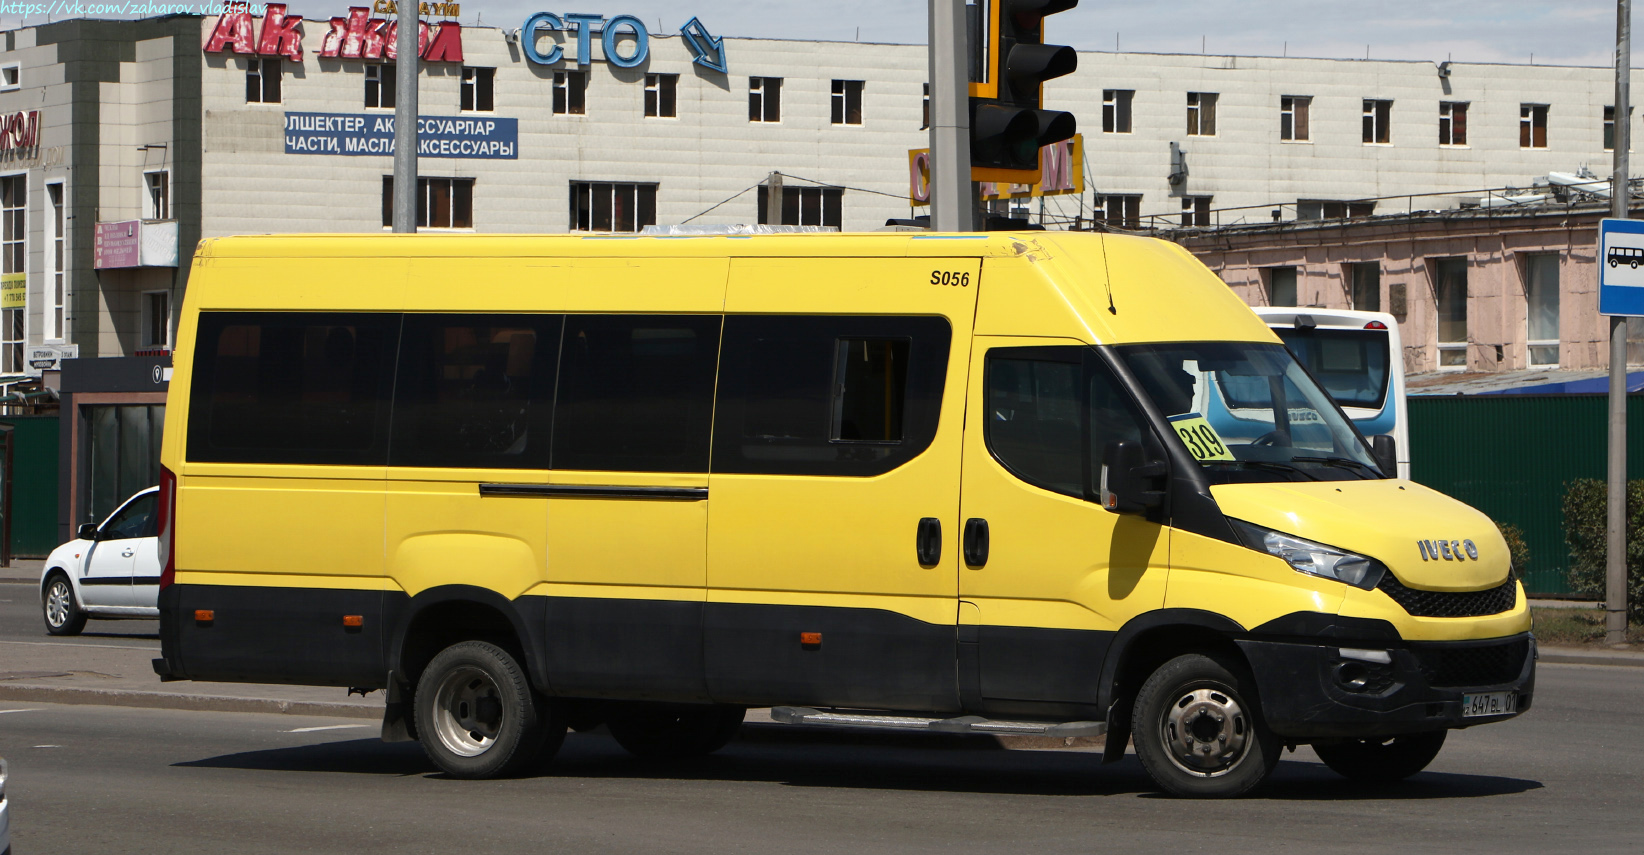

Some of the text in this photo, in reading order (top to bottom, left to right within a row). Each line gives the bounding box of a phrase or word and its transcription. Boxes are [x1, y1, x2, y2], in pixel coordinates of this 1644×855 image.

[521, 11, 649, 68] СТО
[373, 118, 495, 136] АКССУАРЛАР
[930, 270, 970, 287] S056
[1179, 424, 1225, 460] 319
[1417, 538, 1479, 562] IVECO
